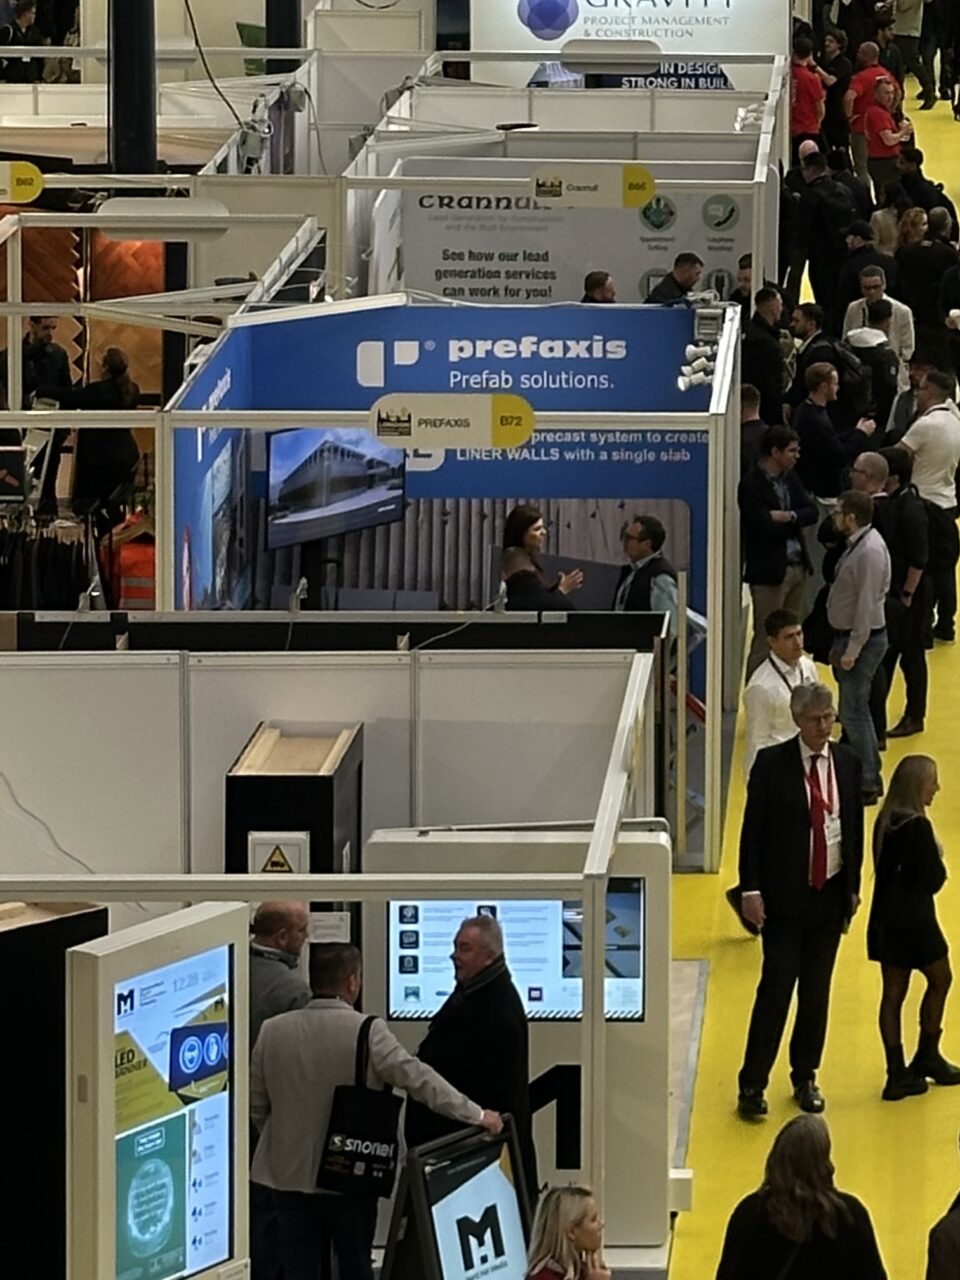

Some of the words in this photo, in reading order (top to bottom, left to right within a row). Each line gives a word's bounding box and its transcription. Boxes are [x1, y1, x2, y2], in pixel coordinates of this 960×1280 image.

[583, 16, 637, 25] PROJECT
[641, 16, 731, 26] MANAGEMENT
[595, 28, 694, 38] CONSTRUCTION
[660, 61, 675, 74] IN
[677, 61, 722, 74] DESIG
[621, 76, 679, 89] STRONG
[681, 76, 696, 89] IN
[442, 249, 465, 262] See
[468, 249, 495, 262] how
[498, 251, 520, 262] our
[522, 249, 549, 262] lead
[434, 268, 501, 281] generation
[504, 267, 557, 281] services
[442, 286, 465, 297] can
[468, 286, 500, 297] work
[504, 285, 523, 297] for
[525, 285, 553, 299] you!
[448, 335, 628, 362] prefaxis
[449, 370, 513, 389] Prefab
[520, 370, 615, 389] solutions.
[417, 417, 471, 429] PREFAXIS
[499, 415, 523, 427] B72
[531, 431, 586, 445] precast
[589, 432, 643, 446] system
[646, 431, 662, 443] to
[664, 431, 709, 443] create
[456, 448, 502, 461] LINER
[507, 448, 560, 461] WALLS
[563, 449, 595, 461] with
[599, 450, 608, 461] a
[611, 449, 656, 464] single
[659, 448, 691, 461] slab
[115, 1048, 136, 1068] LED
